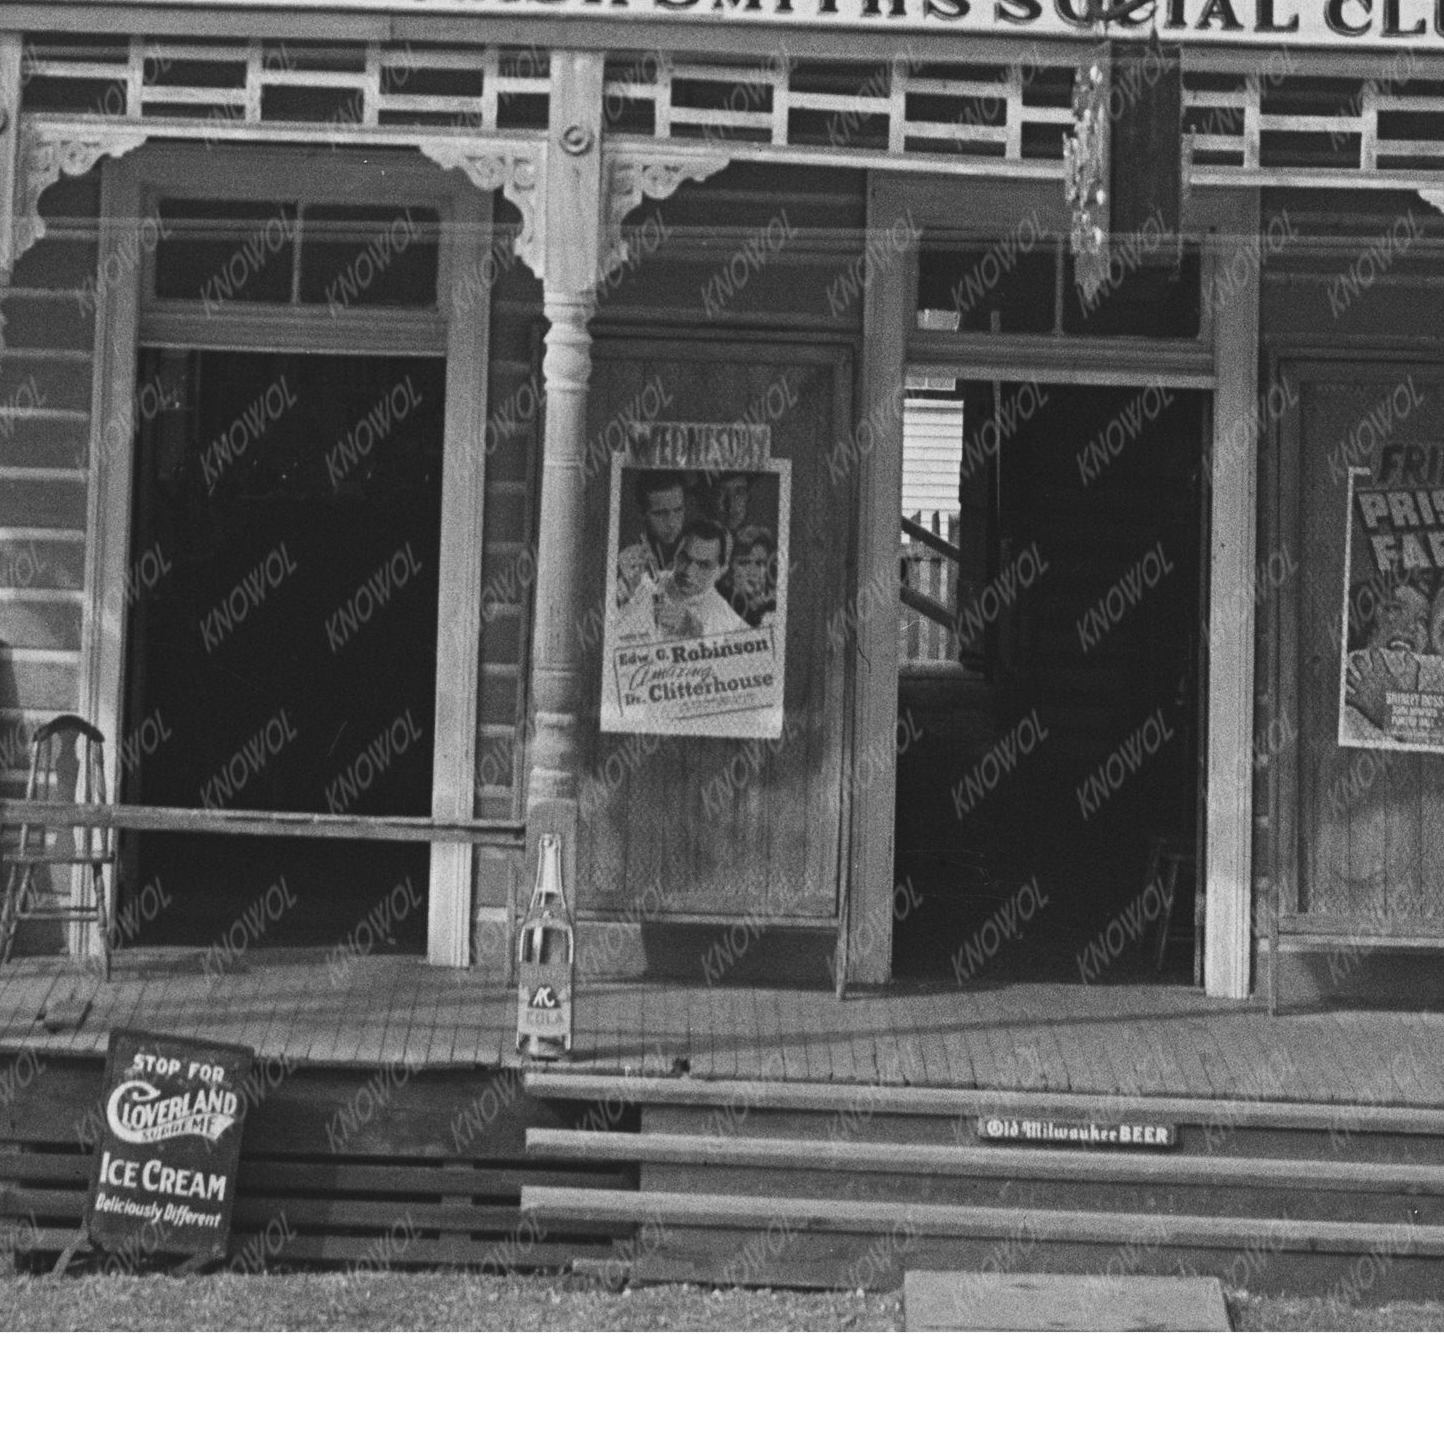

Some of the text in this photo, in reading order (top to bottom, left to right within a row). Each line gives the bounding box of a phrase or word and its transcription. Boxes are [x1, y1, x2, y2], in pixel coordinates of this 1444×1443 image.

[671, 638, 769, 665] Robinson
[648, 673, 774, 703] Clitterhouse
[526, 1011, 564, 1026] COLA
[133, 1053, 225, 1082] STOP FOR
[107, 1080, 238, 1144] CLOVERLAND
[987, 1119, 1168, 1144] Old Milwaukee BEER
[100, 1151, 227, 1201] ICE CREAM
[95, 1192, 222, 1229] Deliciously Different
